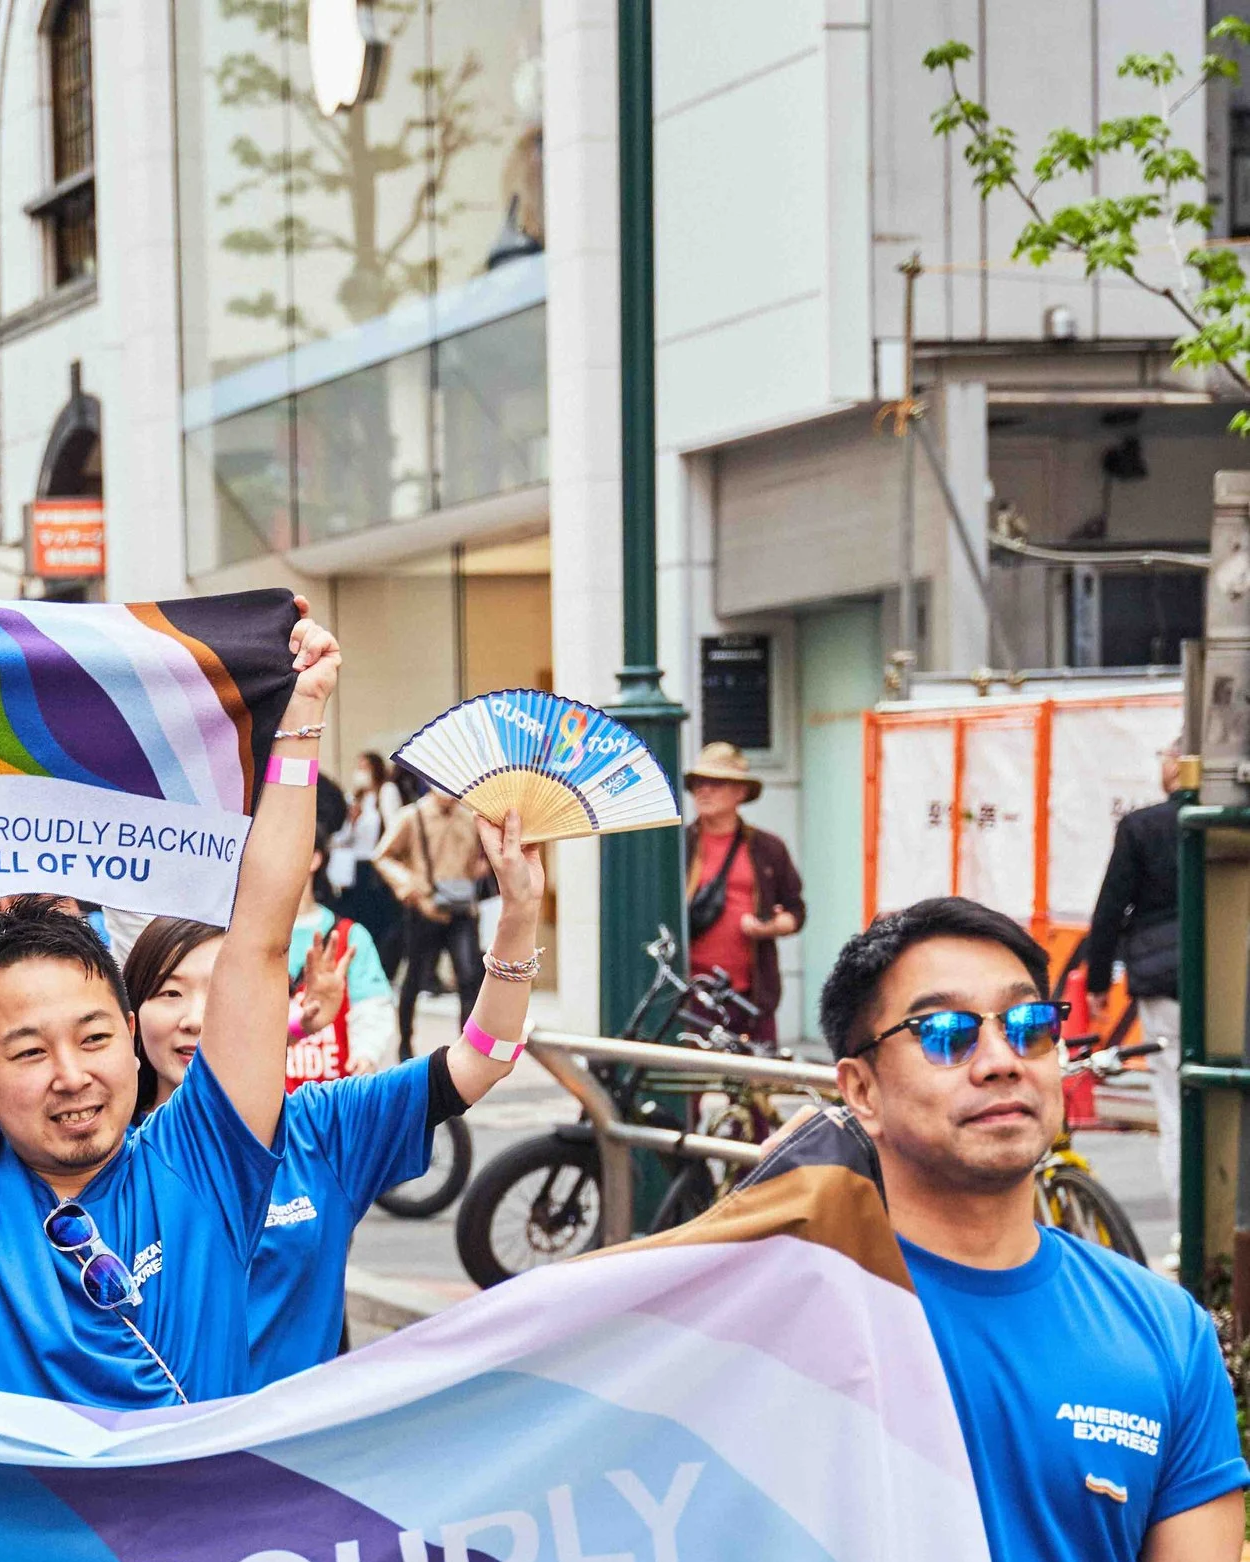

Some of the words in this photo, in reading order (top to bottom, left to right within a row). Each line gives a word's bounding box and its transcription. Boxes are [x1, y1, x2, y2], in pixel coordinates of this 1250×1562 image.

[119, 822, 237, 864] BACKING
[37, 852, 78, 876] OF
[87, 855, 151, 883] YOU
[1055, 1402, 1161, 1439] AMERICAN
[1073, 1421, 1159, 1456] EXPRESS
